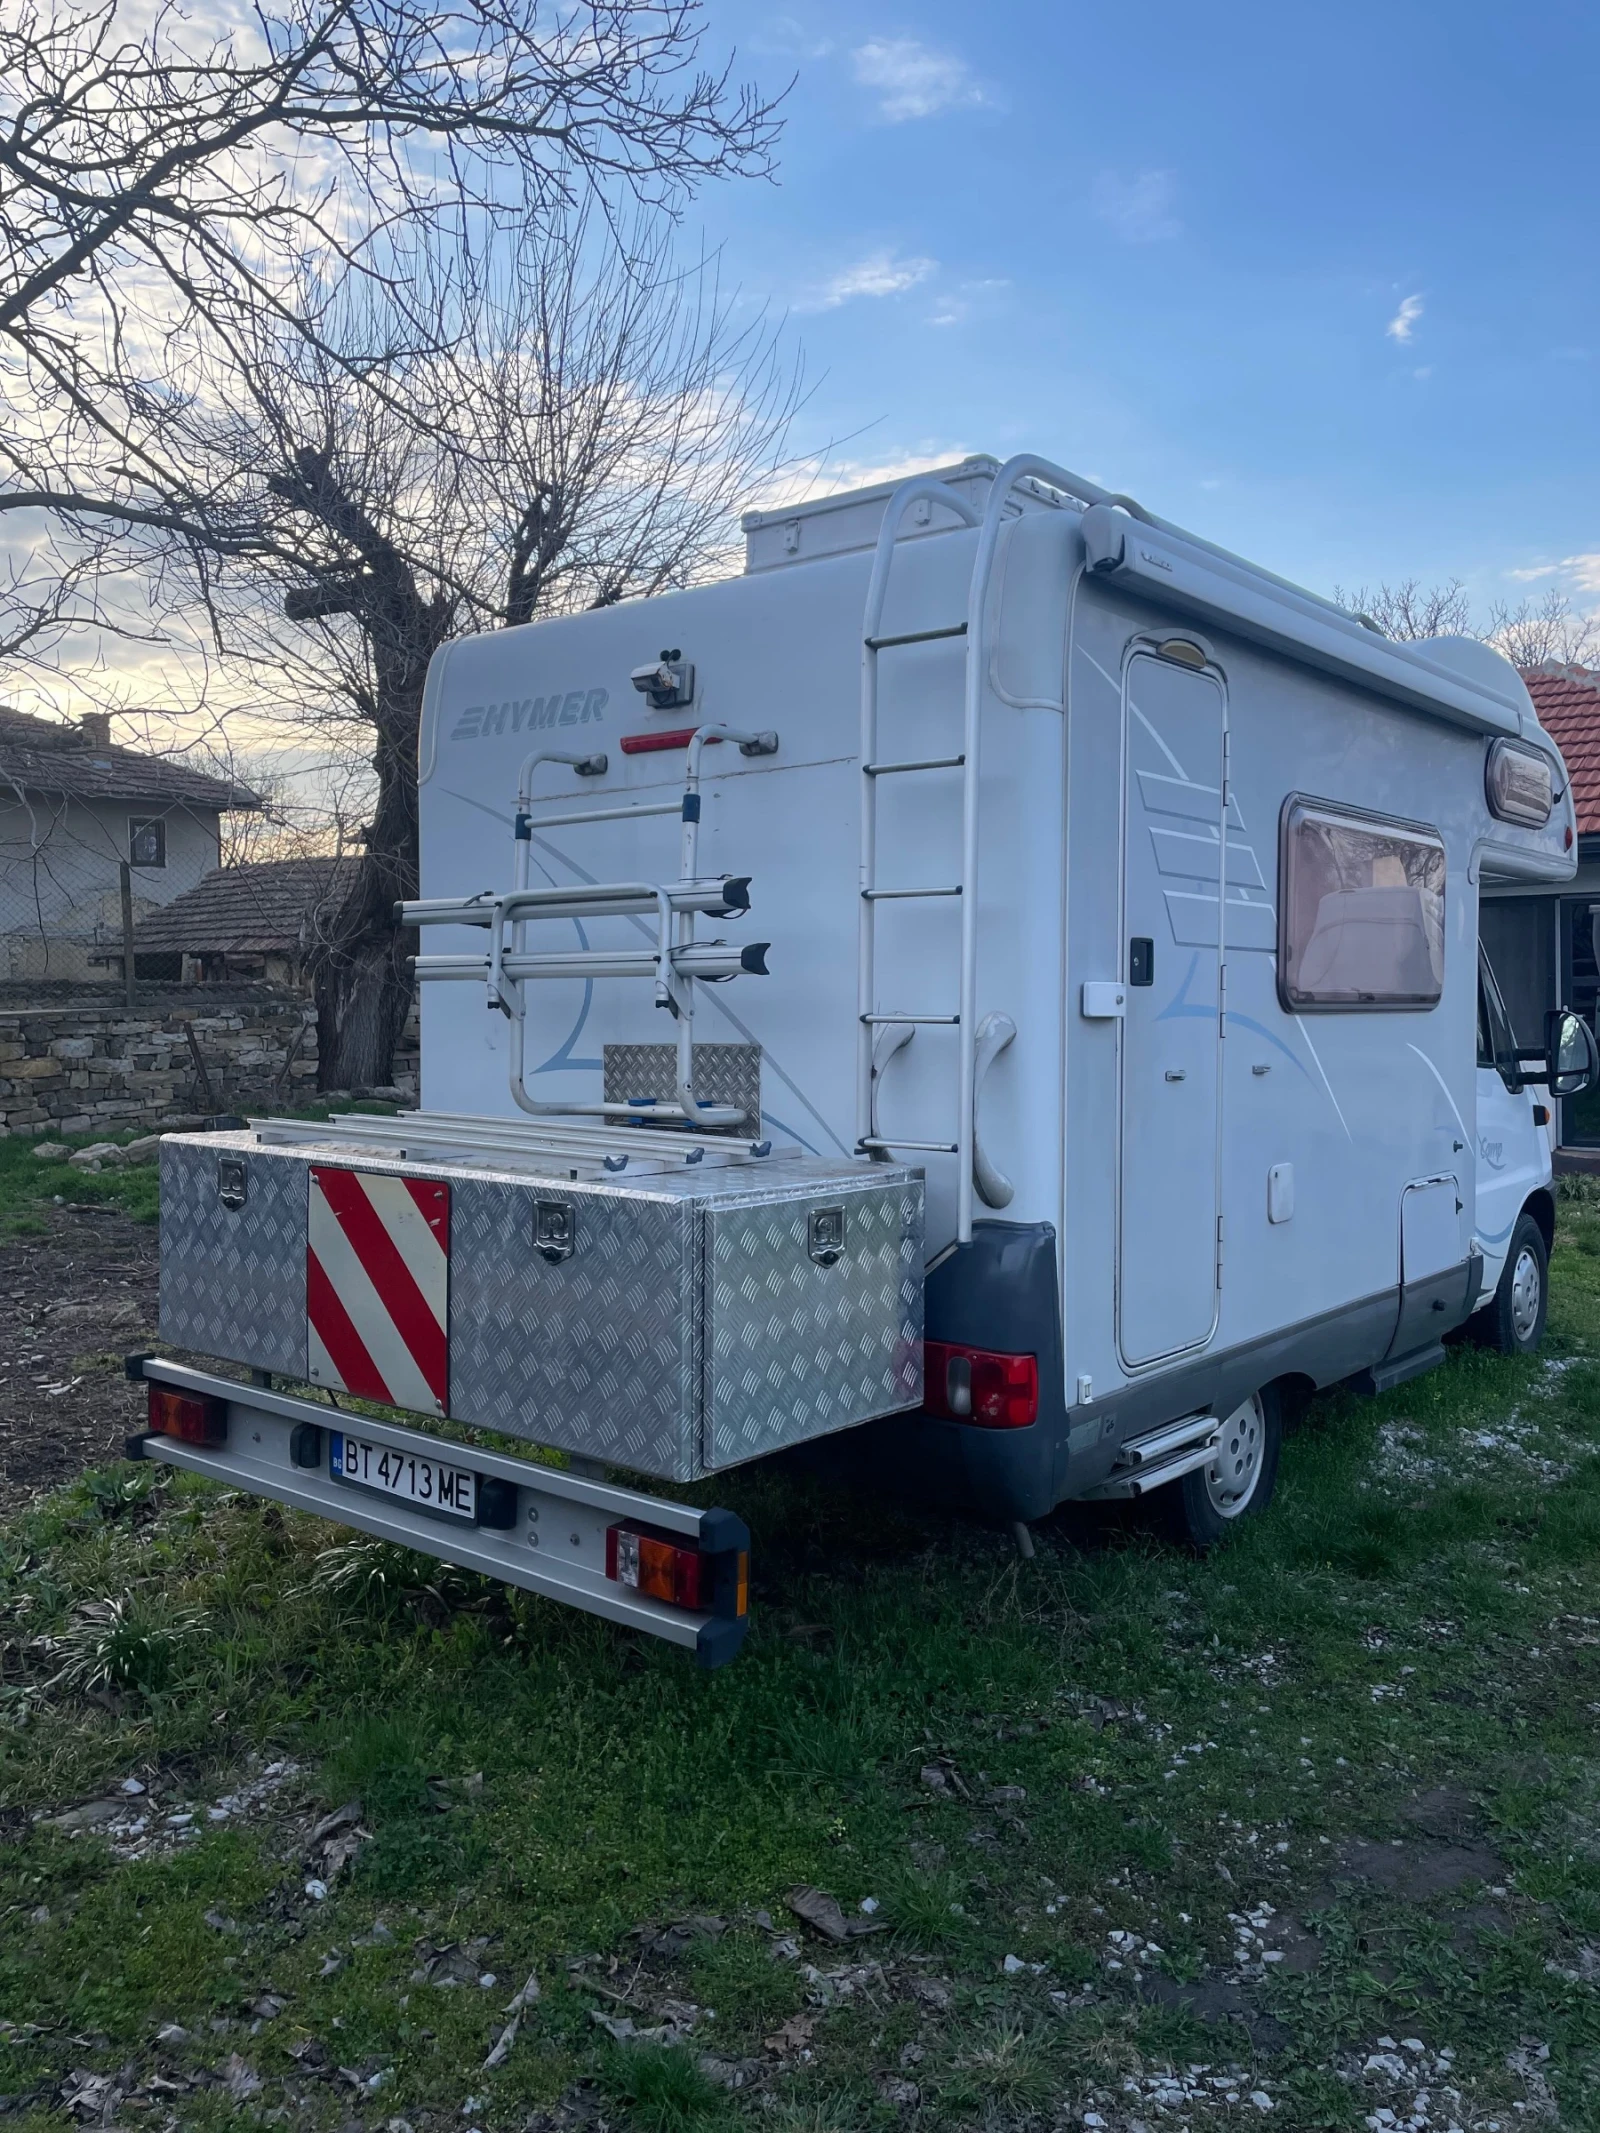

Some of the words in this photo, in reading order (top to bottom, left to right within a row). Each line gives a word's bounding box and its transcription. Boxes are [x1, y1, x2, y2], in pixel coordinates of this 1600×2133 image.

[480, 687, 610, 737] HYMER
[332, 1456, 342, 1470] BG
[346, 1439, 373, 1479] BT
[377, 1451, 433, 1499] 4713
[438, 1467, 471, 1512] ME
